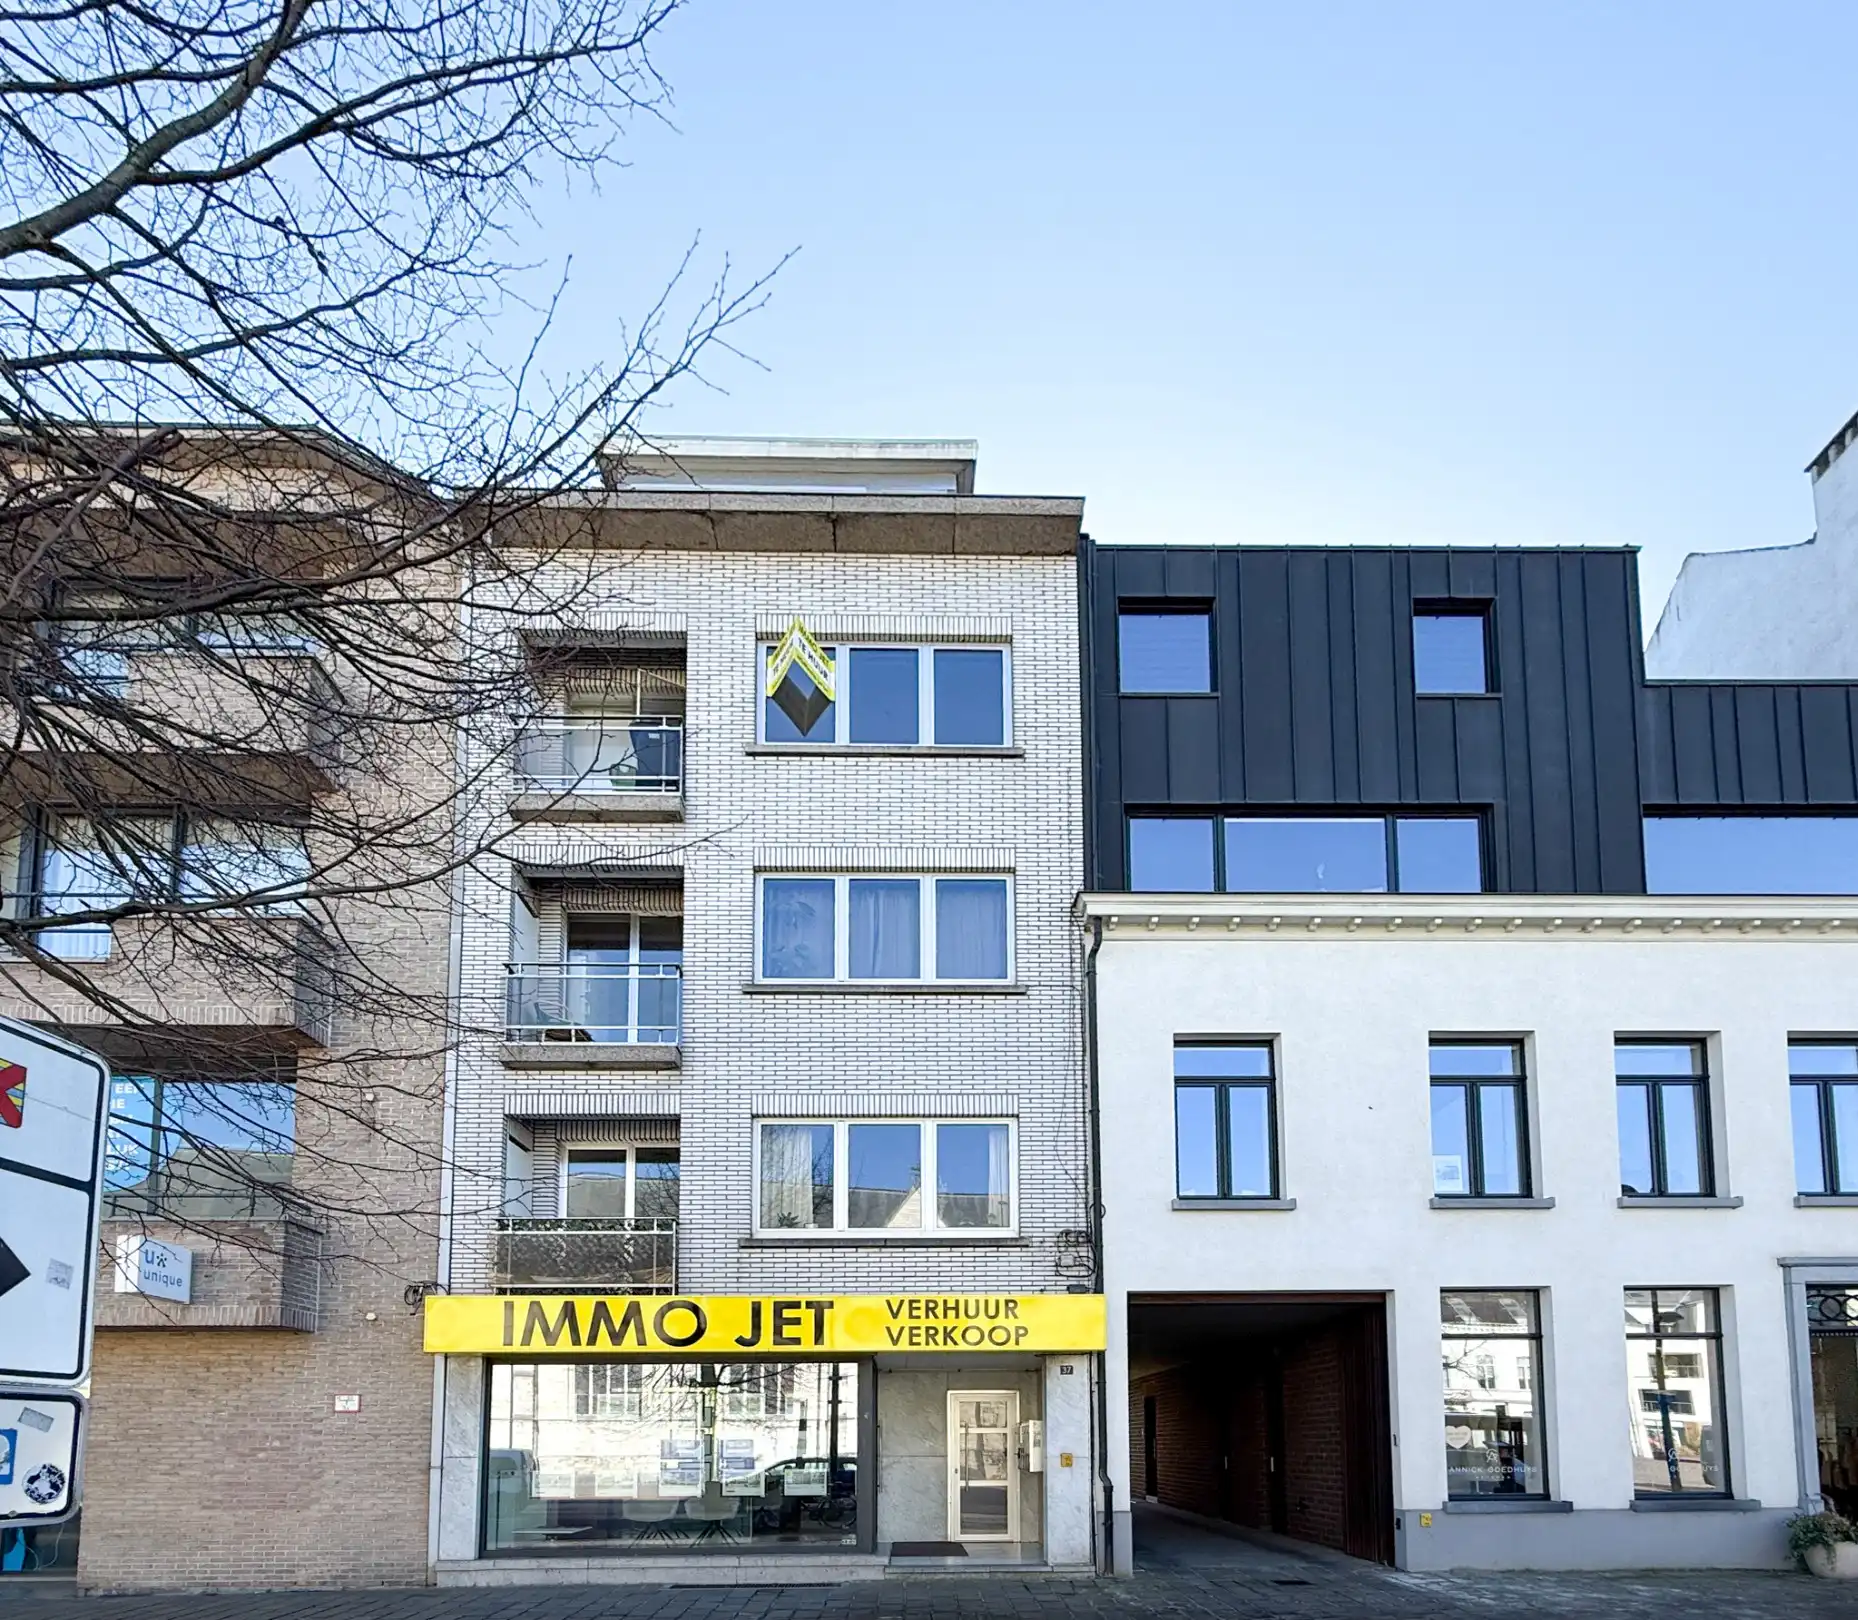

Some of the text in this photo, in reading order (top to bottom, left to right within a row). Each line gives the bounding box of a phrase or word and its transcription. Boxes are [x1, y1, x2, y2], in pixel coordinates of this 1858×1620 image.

[808, 651, 829, 681] HUUR
[143, 1269, 183, 1288] unique
[886, 1299, 1018, 1320] VERHUUR
[503, 1300, 834, 1347] IMMO JET
[886, 1325, 1029, 1346] VERKOOP
